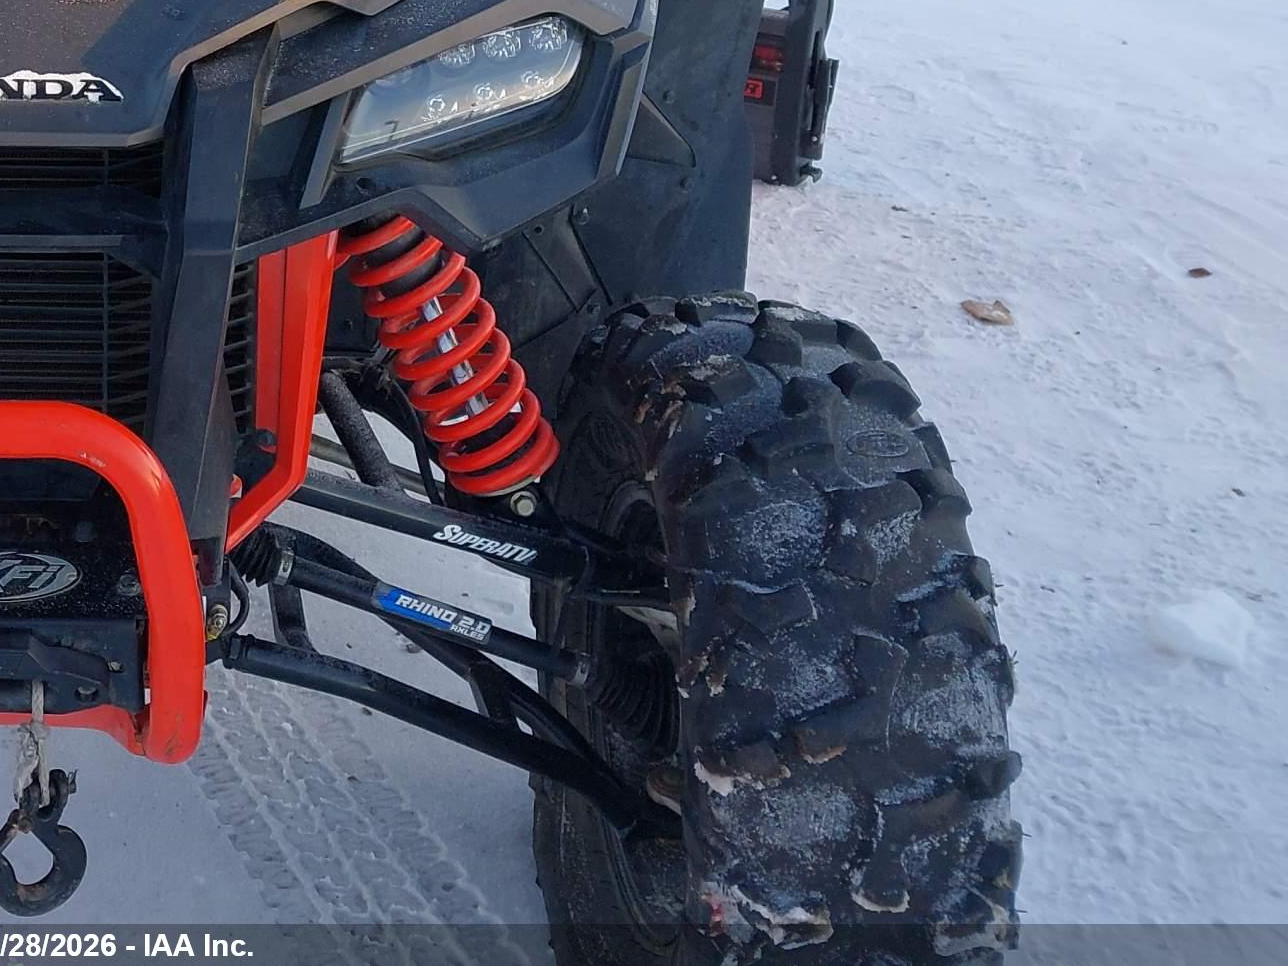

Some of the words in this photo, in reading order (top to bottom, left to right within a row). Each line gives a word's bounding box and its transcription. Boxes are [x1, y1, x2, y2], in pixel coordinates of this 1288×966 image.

[394, 593, 458, 623] RHINO
[457, 614, 492, 636] 2.0
[449, 623, 486, 642] AXLES
